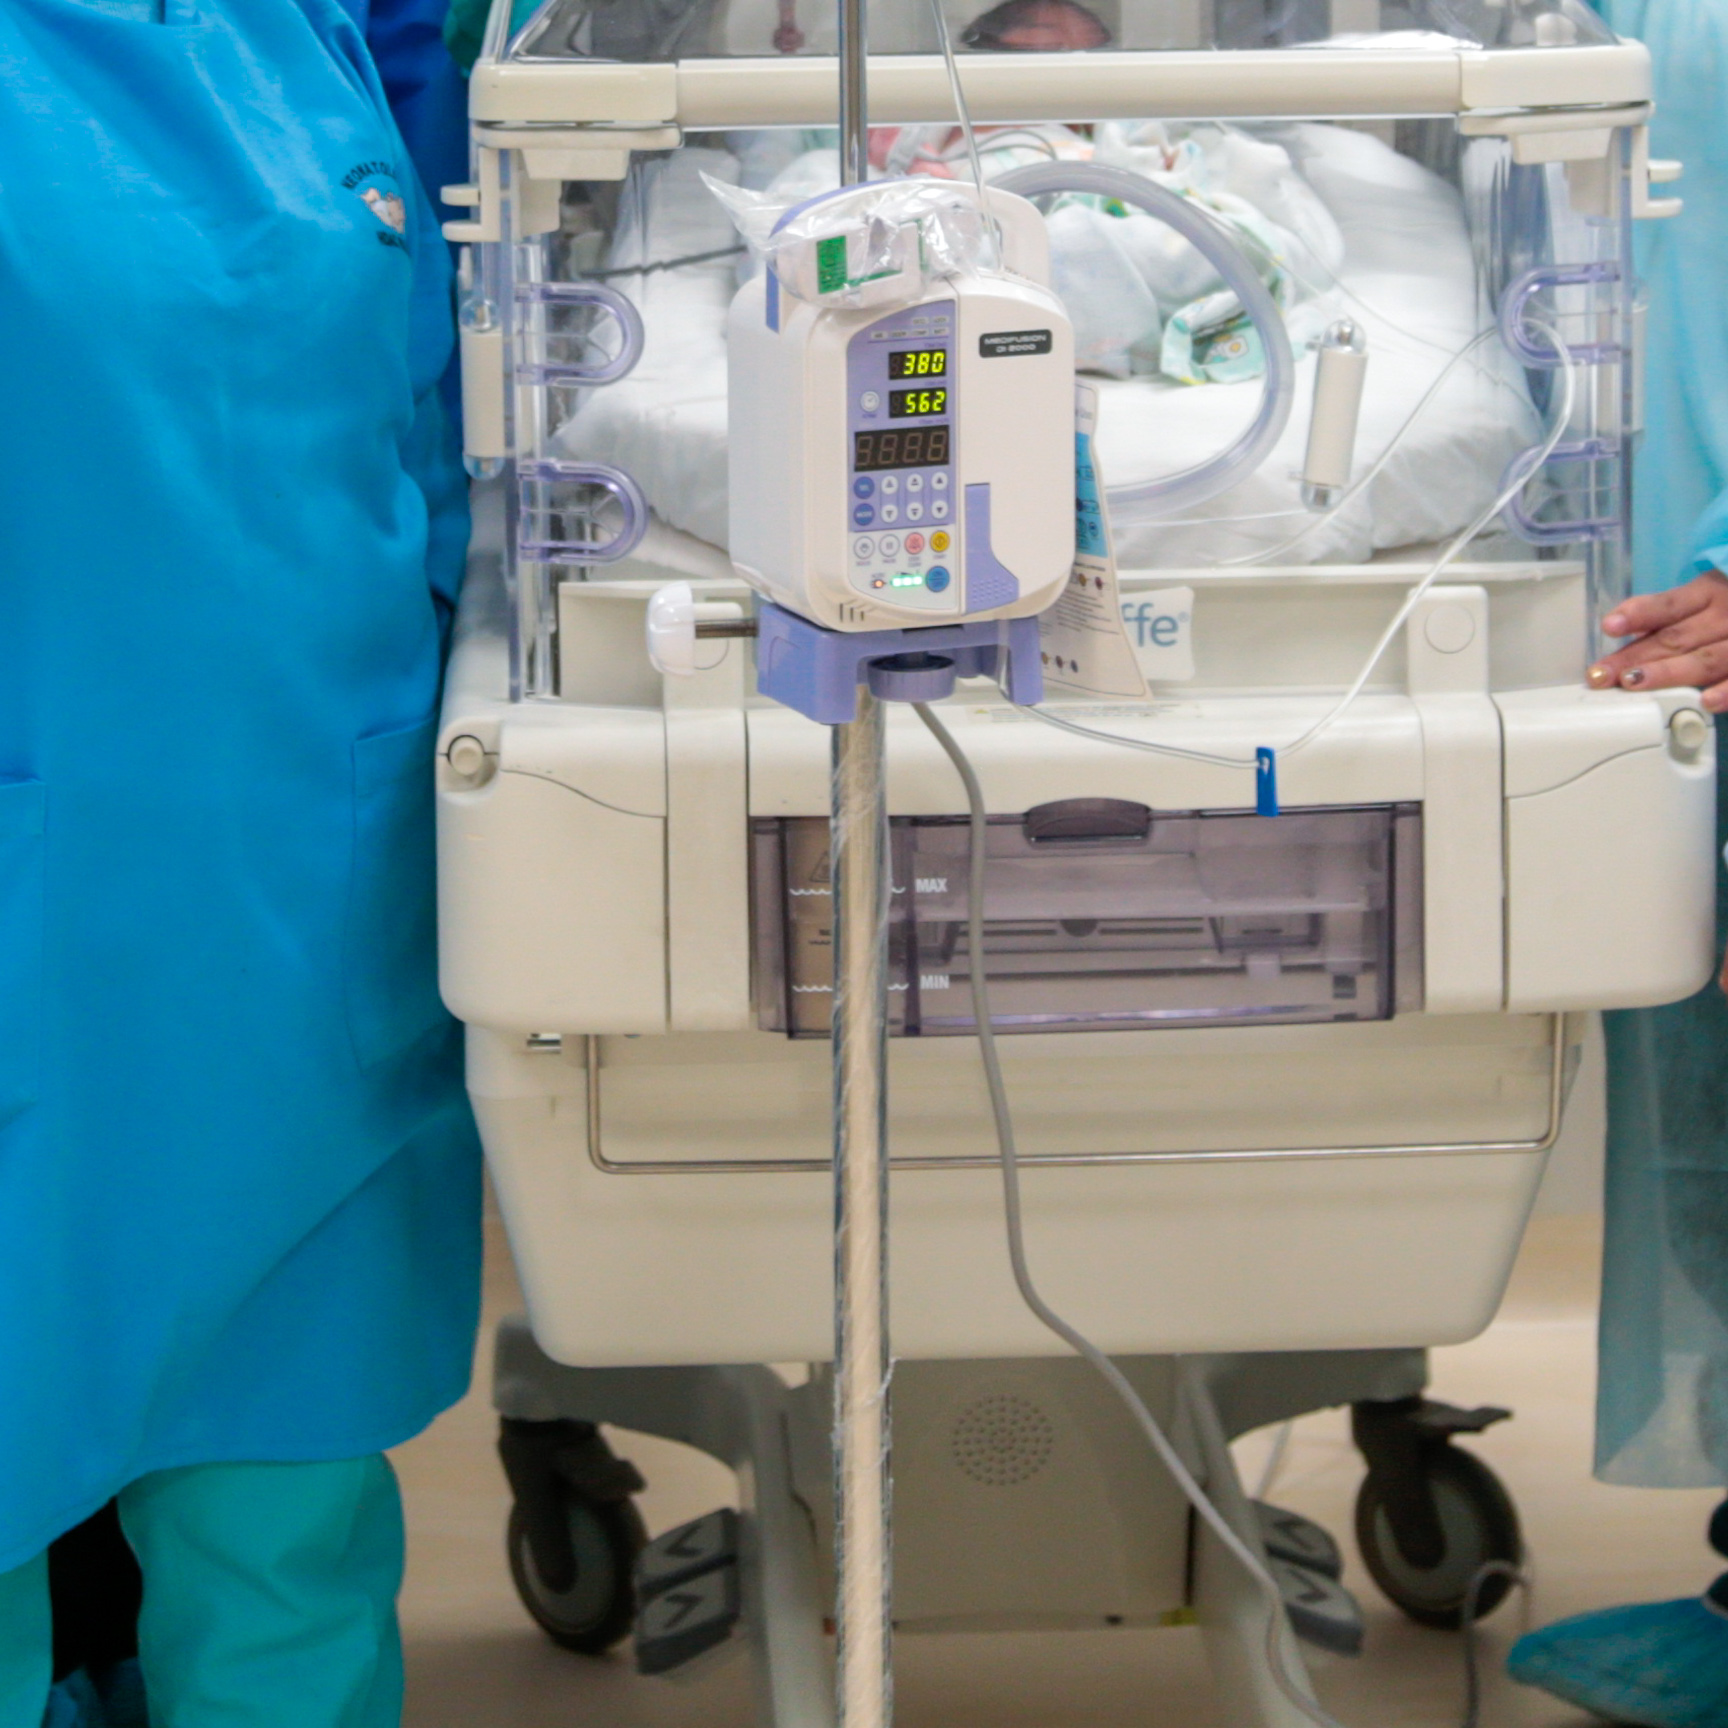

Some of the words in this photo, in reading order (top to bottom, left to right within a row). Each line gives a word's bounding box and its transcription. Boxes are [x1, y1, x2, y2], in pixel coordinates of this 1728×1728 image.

[903, 352, 945, 375] 380
[905, 391, 946, 414] 562
[915, 878, 948, 892] MAX
[921, 975, 949, 989] MIN
